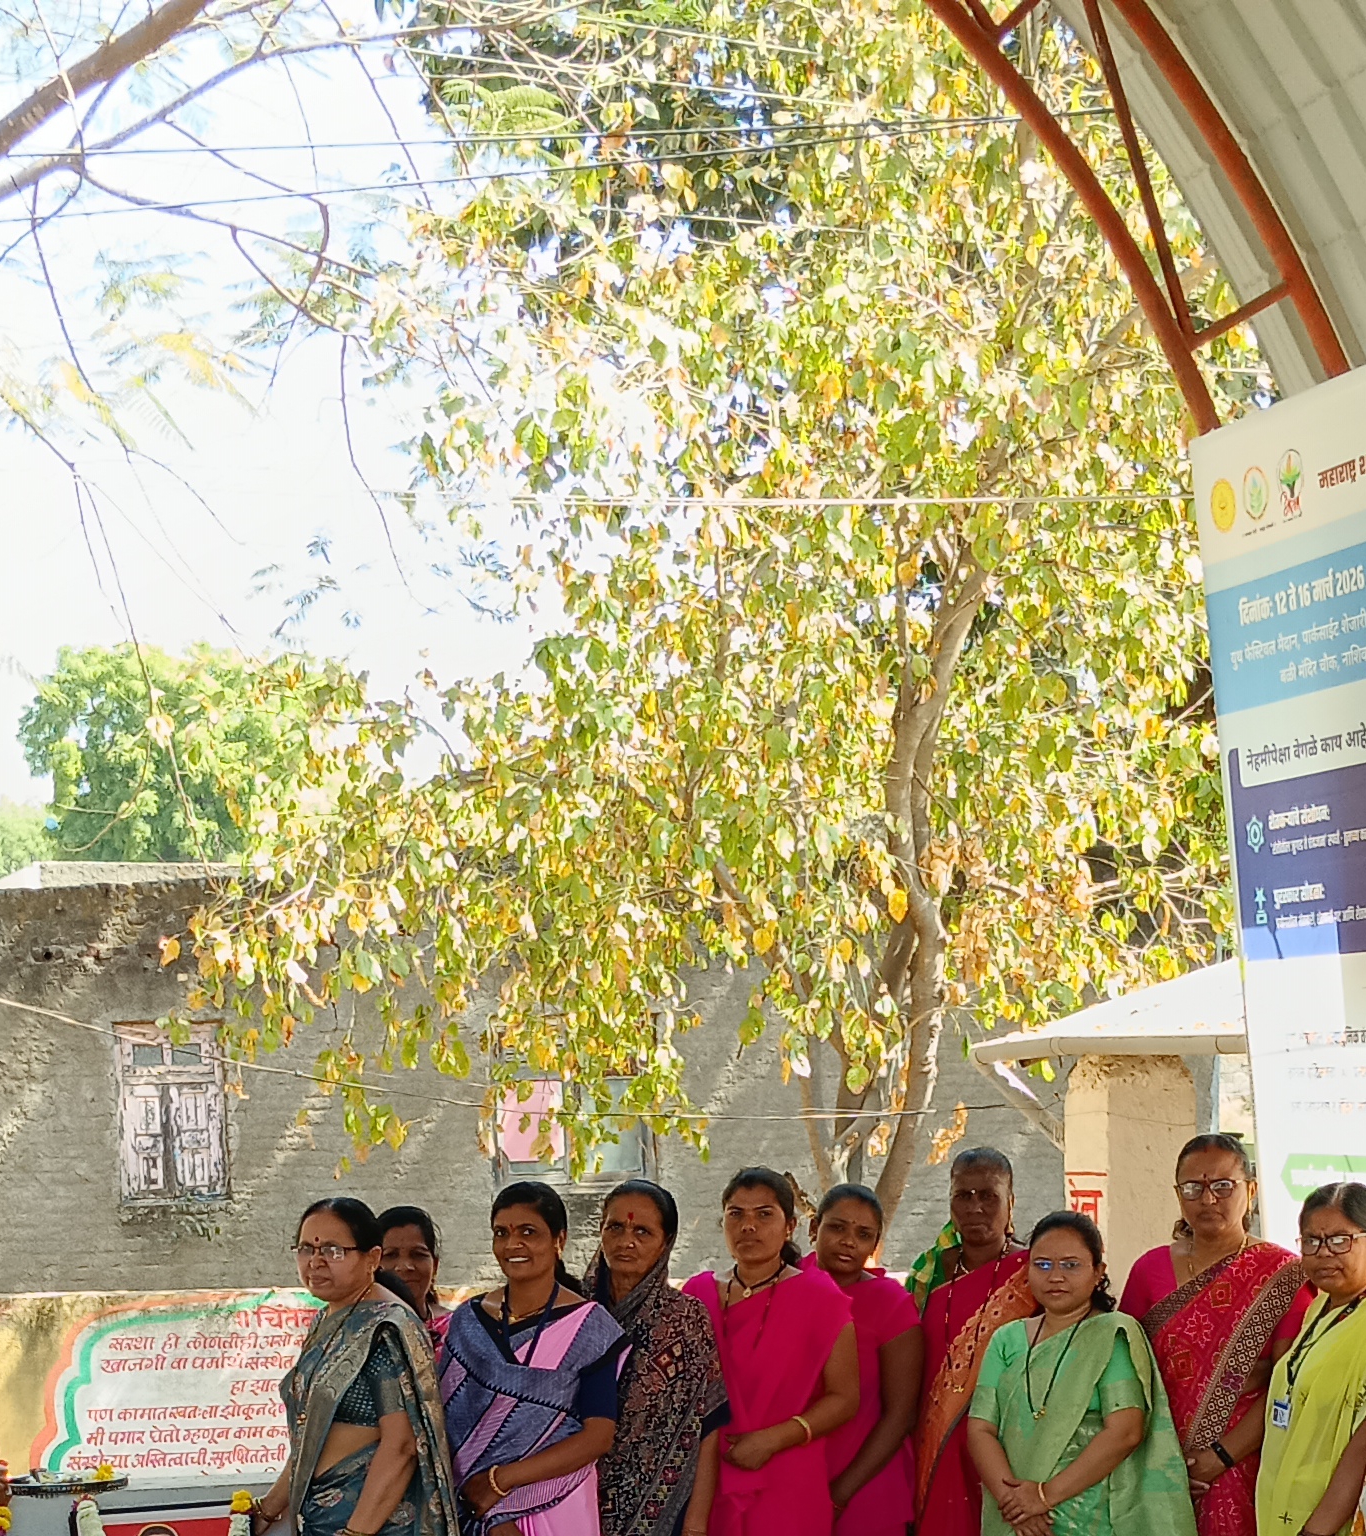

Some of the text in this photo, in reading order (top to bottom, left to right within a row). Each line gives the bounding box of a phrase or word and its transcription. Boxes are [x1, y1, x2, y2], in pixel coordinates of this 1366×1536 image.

[1318, 459, 1356, 489] महाराष्ट्र
[1239, 594, 1274, 626] दिनांक:
[1275, 591, 1287, 615] 12
[1298, 583, 1311, 607] 16
[1311, 568, 1334, 602] मार्च
[1335, 565, 1365, 596] 2026
[1246, 744, 1290, 772] नेहमीपेक्षा
[1293, 735, 1318, 759] वेगळे
[1320, 734, 1342, 753] काय
[161, 1333, 180, 1354] ही
[101, 1354, 167, 1374] खाजगी
[171, 1358, 188, 1370] वा
[231, 1380, 247, 1395] हा
[87, 1408, 114, 1422] पण
[117, 1407, 169, 1421] कामात
[220, 1399, 268, 1420] झोकून
[87, 1427, 105, 1446] मी
[109, 1431, 145, 1445] पगार
[150, 1424, 181, 1443] घेतो
[183, 1428, 231, 1444] म्हणून
[234, 1426, 264, 1439] काम
